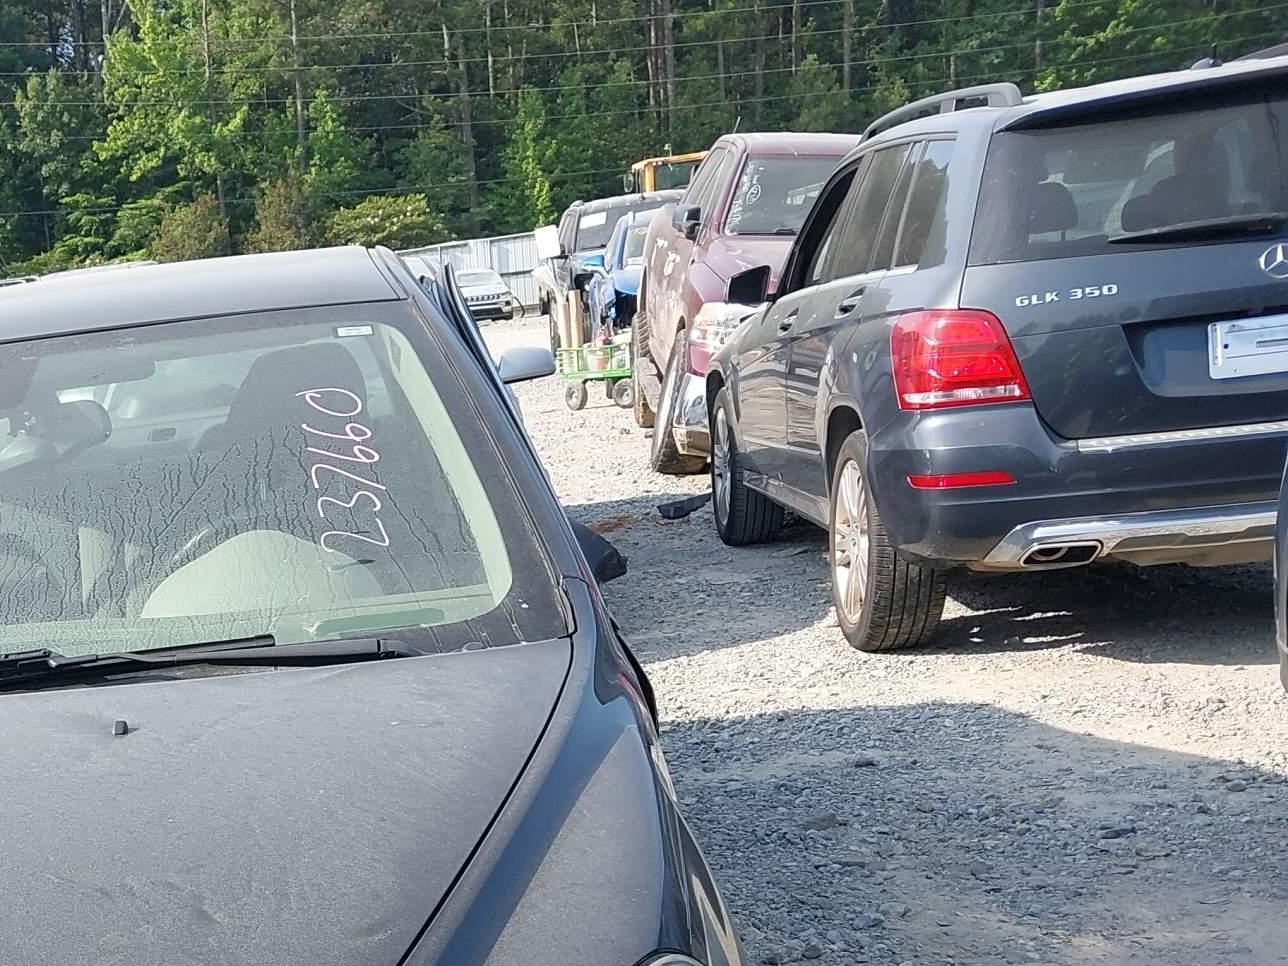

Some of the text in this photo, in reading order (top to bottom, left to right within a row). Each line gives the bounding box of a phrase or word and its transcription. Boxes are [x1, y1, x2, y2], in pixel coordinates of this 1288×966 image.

[1015, 284, 1118, 307] GLK 350
[295, 387, 390, 553] 237660
